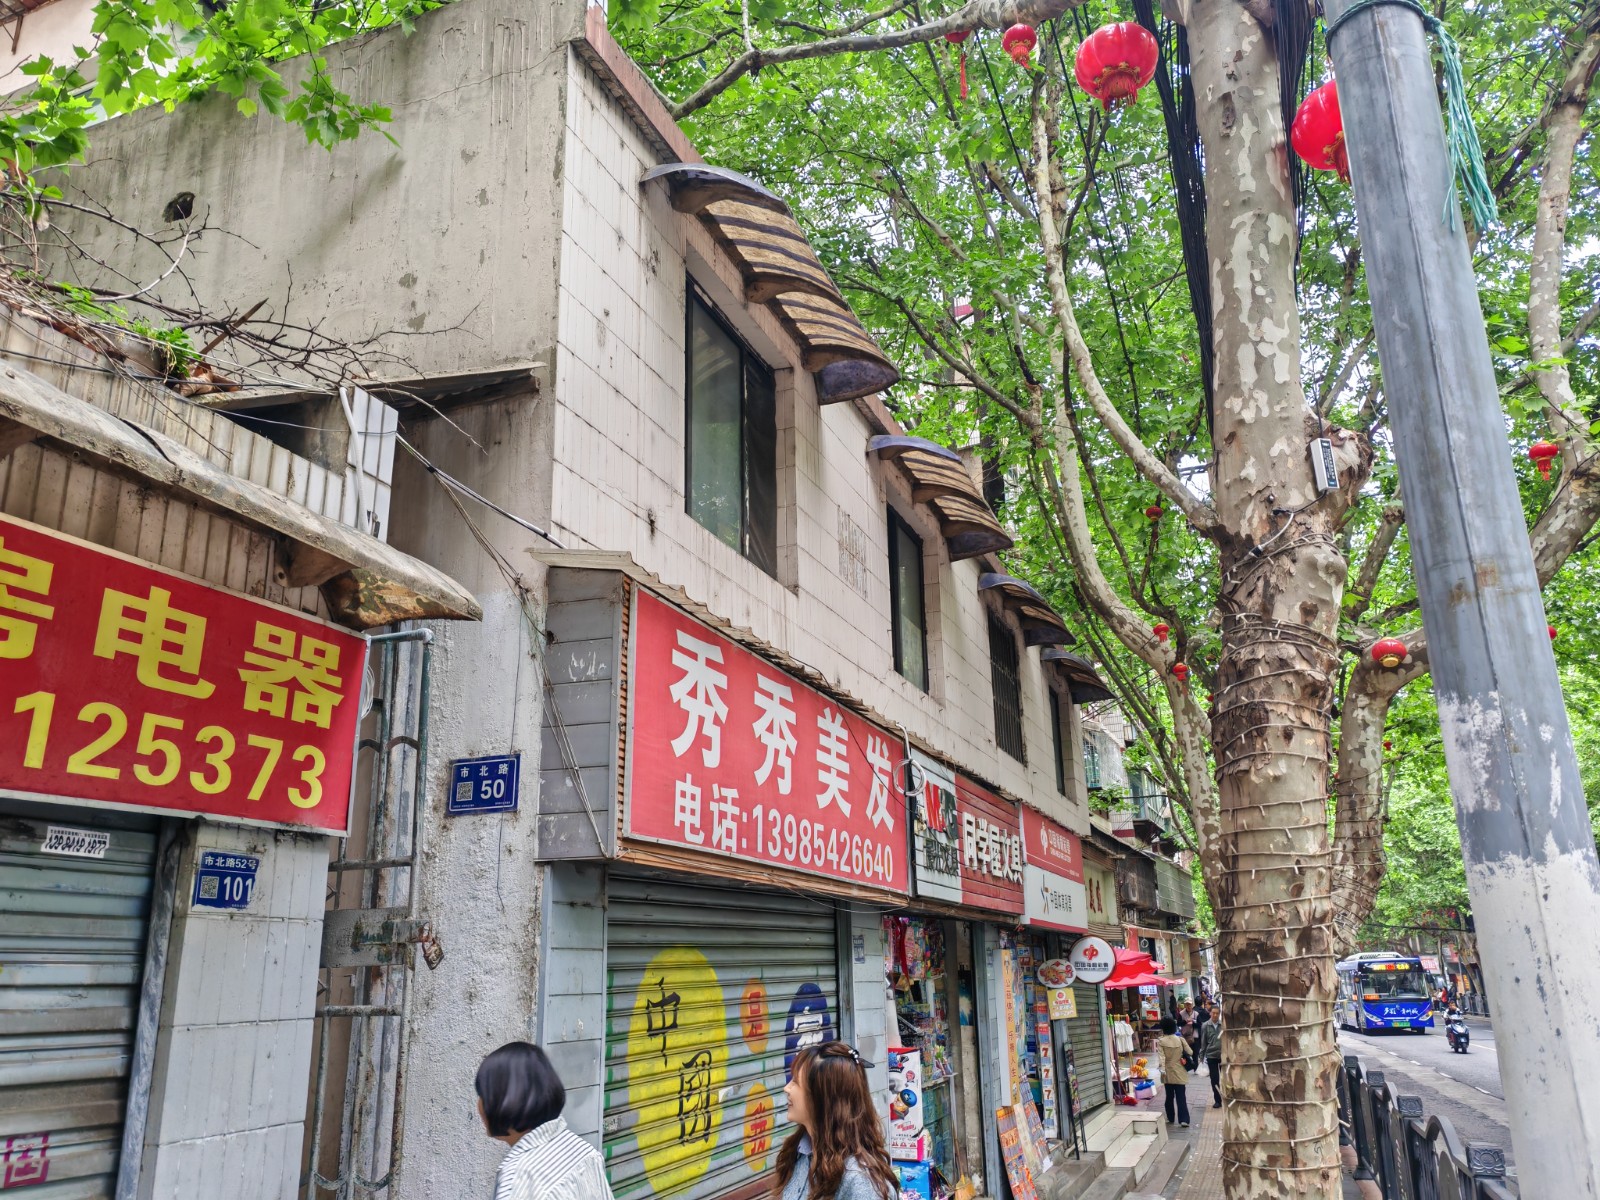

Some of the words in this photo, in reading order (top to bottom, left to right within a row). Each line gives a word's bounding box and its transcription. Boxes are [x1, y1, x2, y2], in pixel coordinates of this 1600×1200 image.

[669, 629, 895, 833] 秀秀美发
[13, 690, 327, 809] 125373
[460, 763, 509, 778] 市北路
[480, 778, 505, 800] 50
[673, 773, 893, 884] 电话:13985426640
[204, 856, 258, 870] 市北路52号
[223, 876, 254, 902] 101
